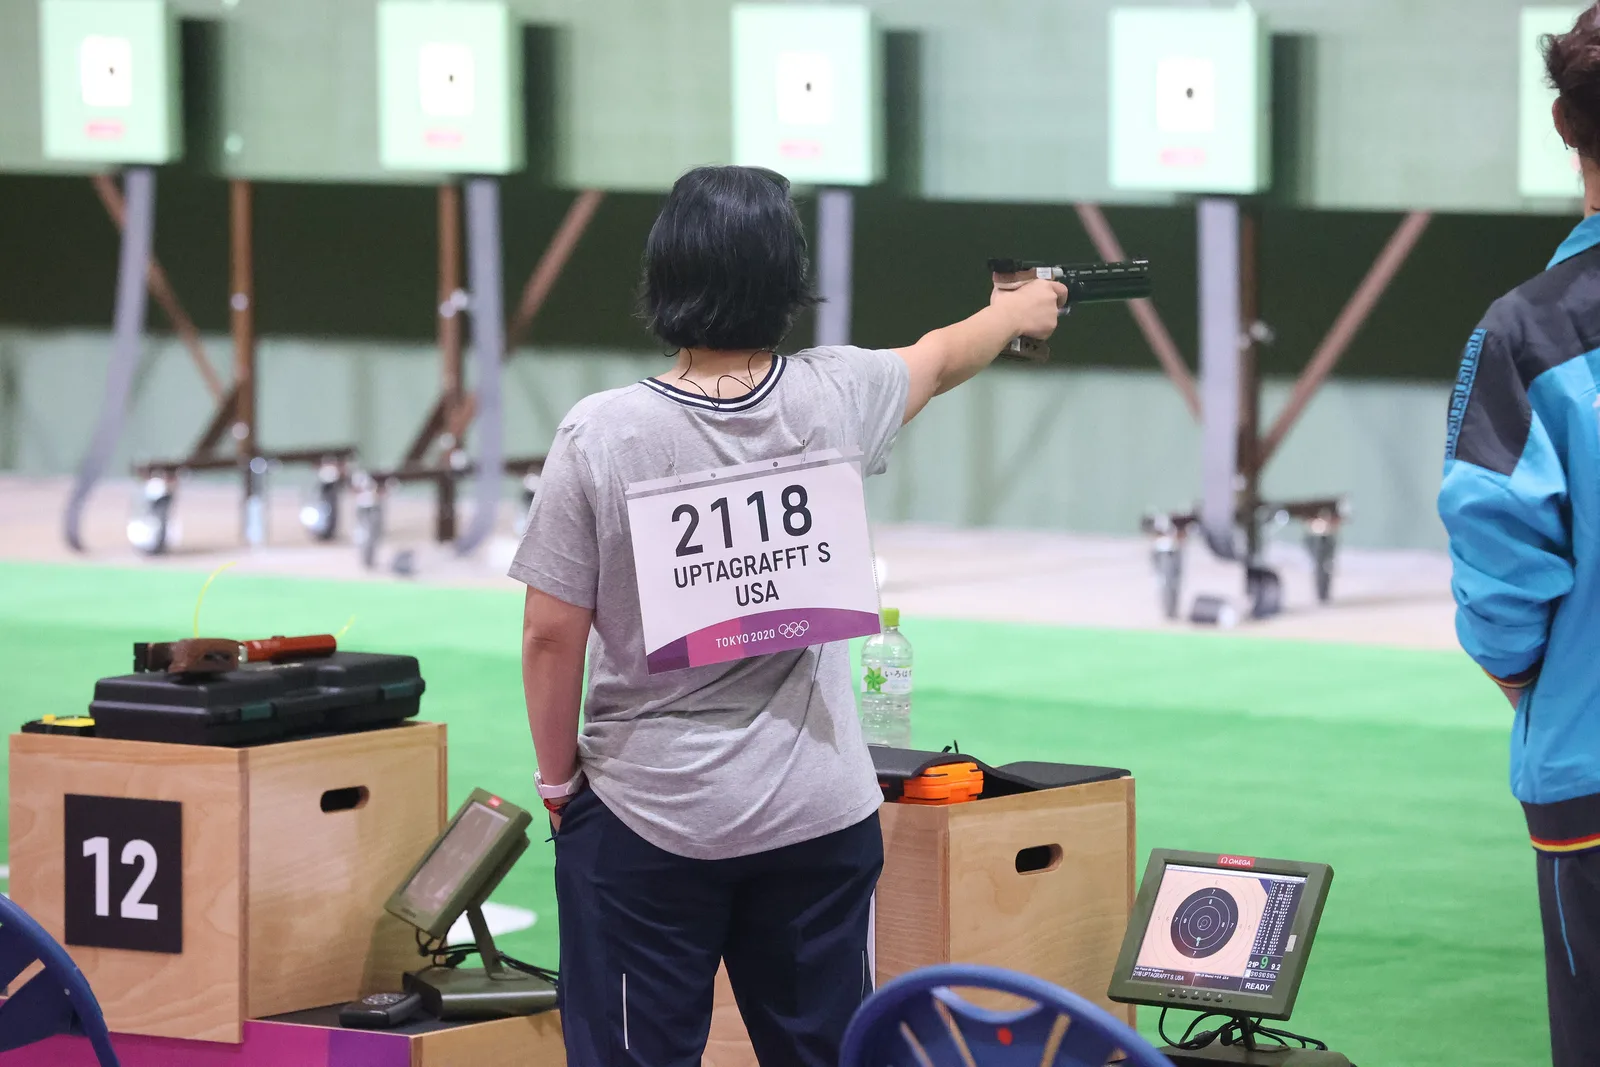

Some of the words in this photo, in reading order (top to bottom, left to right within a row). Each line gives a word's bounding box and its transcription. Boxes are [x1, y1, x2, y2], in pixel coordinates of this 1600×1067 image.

[671, 484, 813, 557] 2118
[673, 544, 810, 588] UPTAGRAFFT
[818, 541, 831, 563] S
[735, 580, 780, 607] USA
[715, 633, 750, 649] TOKYO
[750, 629, 775, 643] 2020
[1228, 858, 1251, 866] OMEGA
[82, 836, 160, 921] 12
[1260, 956, 1269, 969] 9
[1142, 971, 1170, 980] UPTAGRAFFT
[1245, 982, 1270, 992] READY
